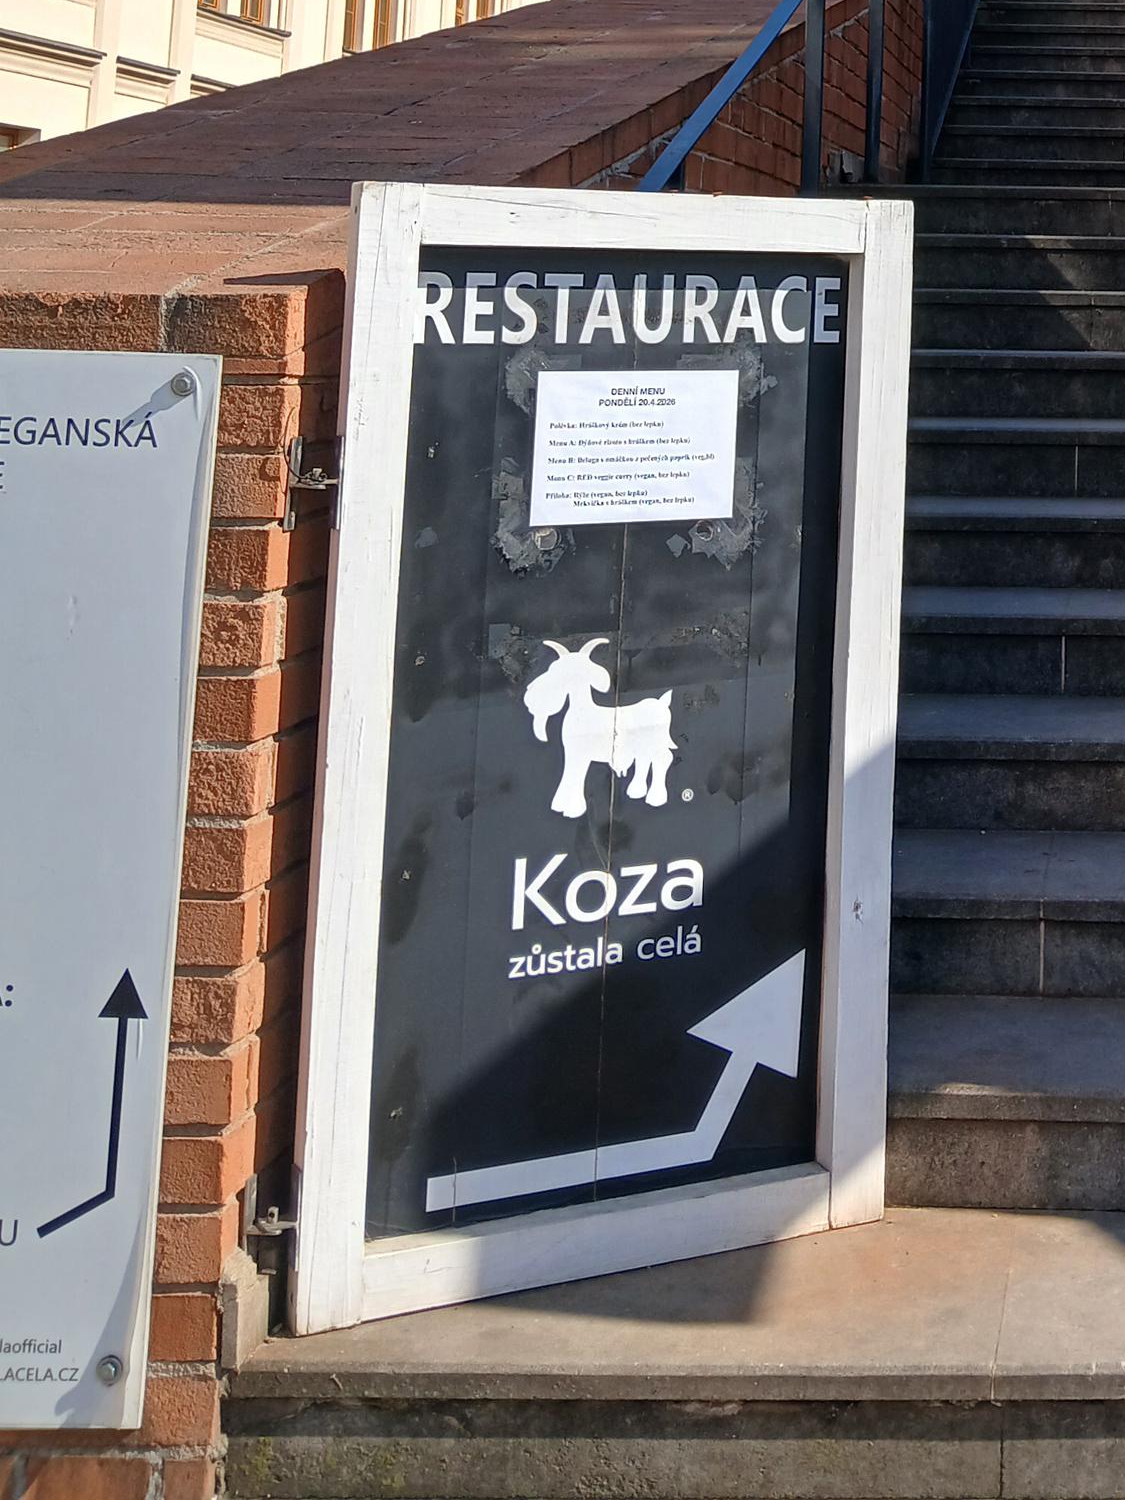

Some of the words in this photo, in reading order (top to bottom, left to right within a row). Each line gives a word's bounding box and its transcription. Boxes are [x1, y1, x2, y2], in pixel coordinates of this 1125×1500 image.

[414, 270, 842, 346] RESTAURACE
[599, 396, 637, 407] PONDĚLÍ
[610, 385, 638, 396] DENNÍ
[640, 388, 666, 396] MENU
[511, 853, 704, 930] Koza
[508, 937, 623, 979] zůstala
[637, 925, 702, 960] celá
